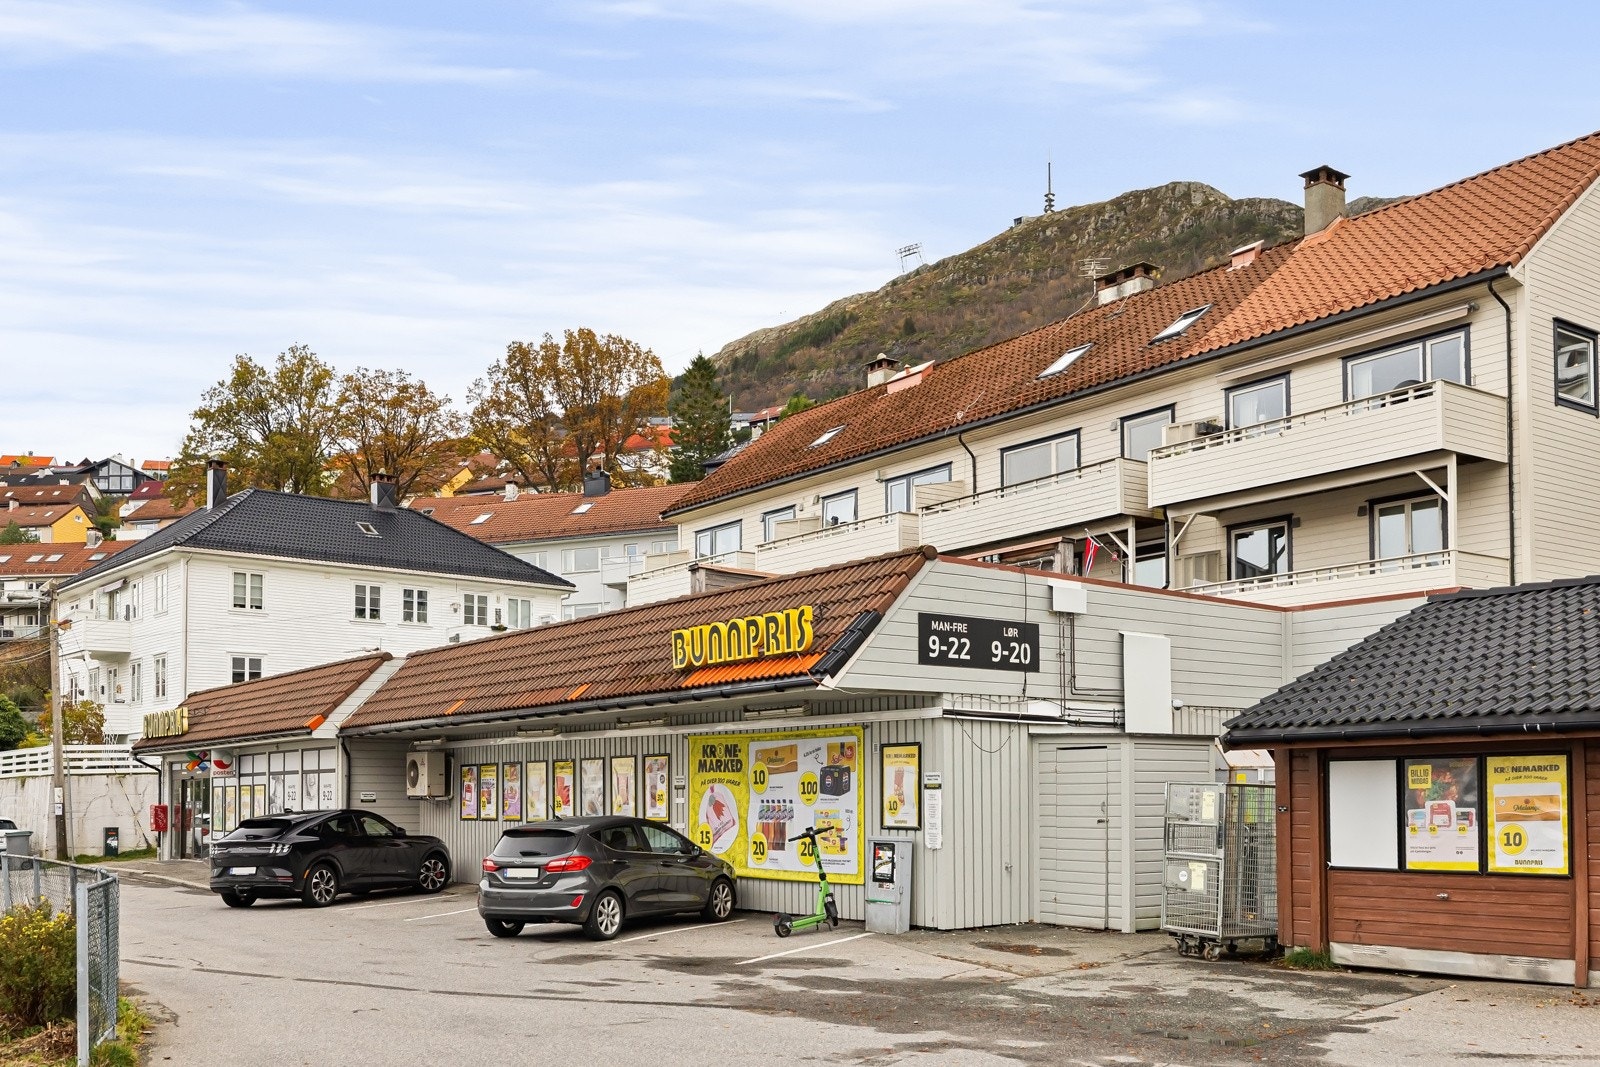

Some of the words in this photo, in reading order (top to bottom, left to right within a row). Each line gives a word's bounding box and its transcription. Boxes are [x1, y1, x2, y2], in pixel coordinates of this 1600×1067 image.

[931, 620, 968, 633] MAN-FRE
[1003, 627, 1019, 637] LØR
[672, 606, 813, 668] BUNNPRIS
[928, 635, 971, 660] 9-22
[991, 640, 1031, 665] 9-20
[697, 758, 743, 773] MARKED
[1493, 764, 1560, 774] KRONEMARKED
[753, 770, 766, 785] 10
[1411, 769, 1429, 778] BILLIG
[800, 781, 818, 795] 100
[888, 800, 898, 811] 10
[699, 830, 711, 845] 15
[1503, 832, 1523, 847] 10
[752, 840, 765, 856] 20
[800, 841, 814, 857] 20
